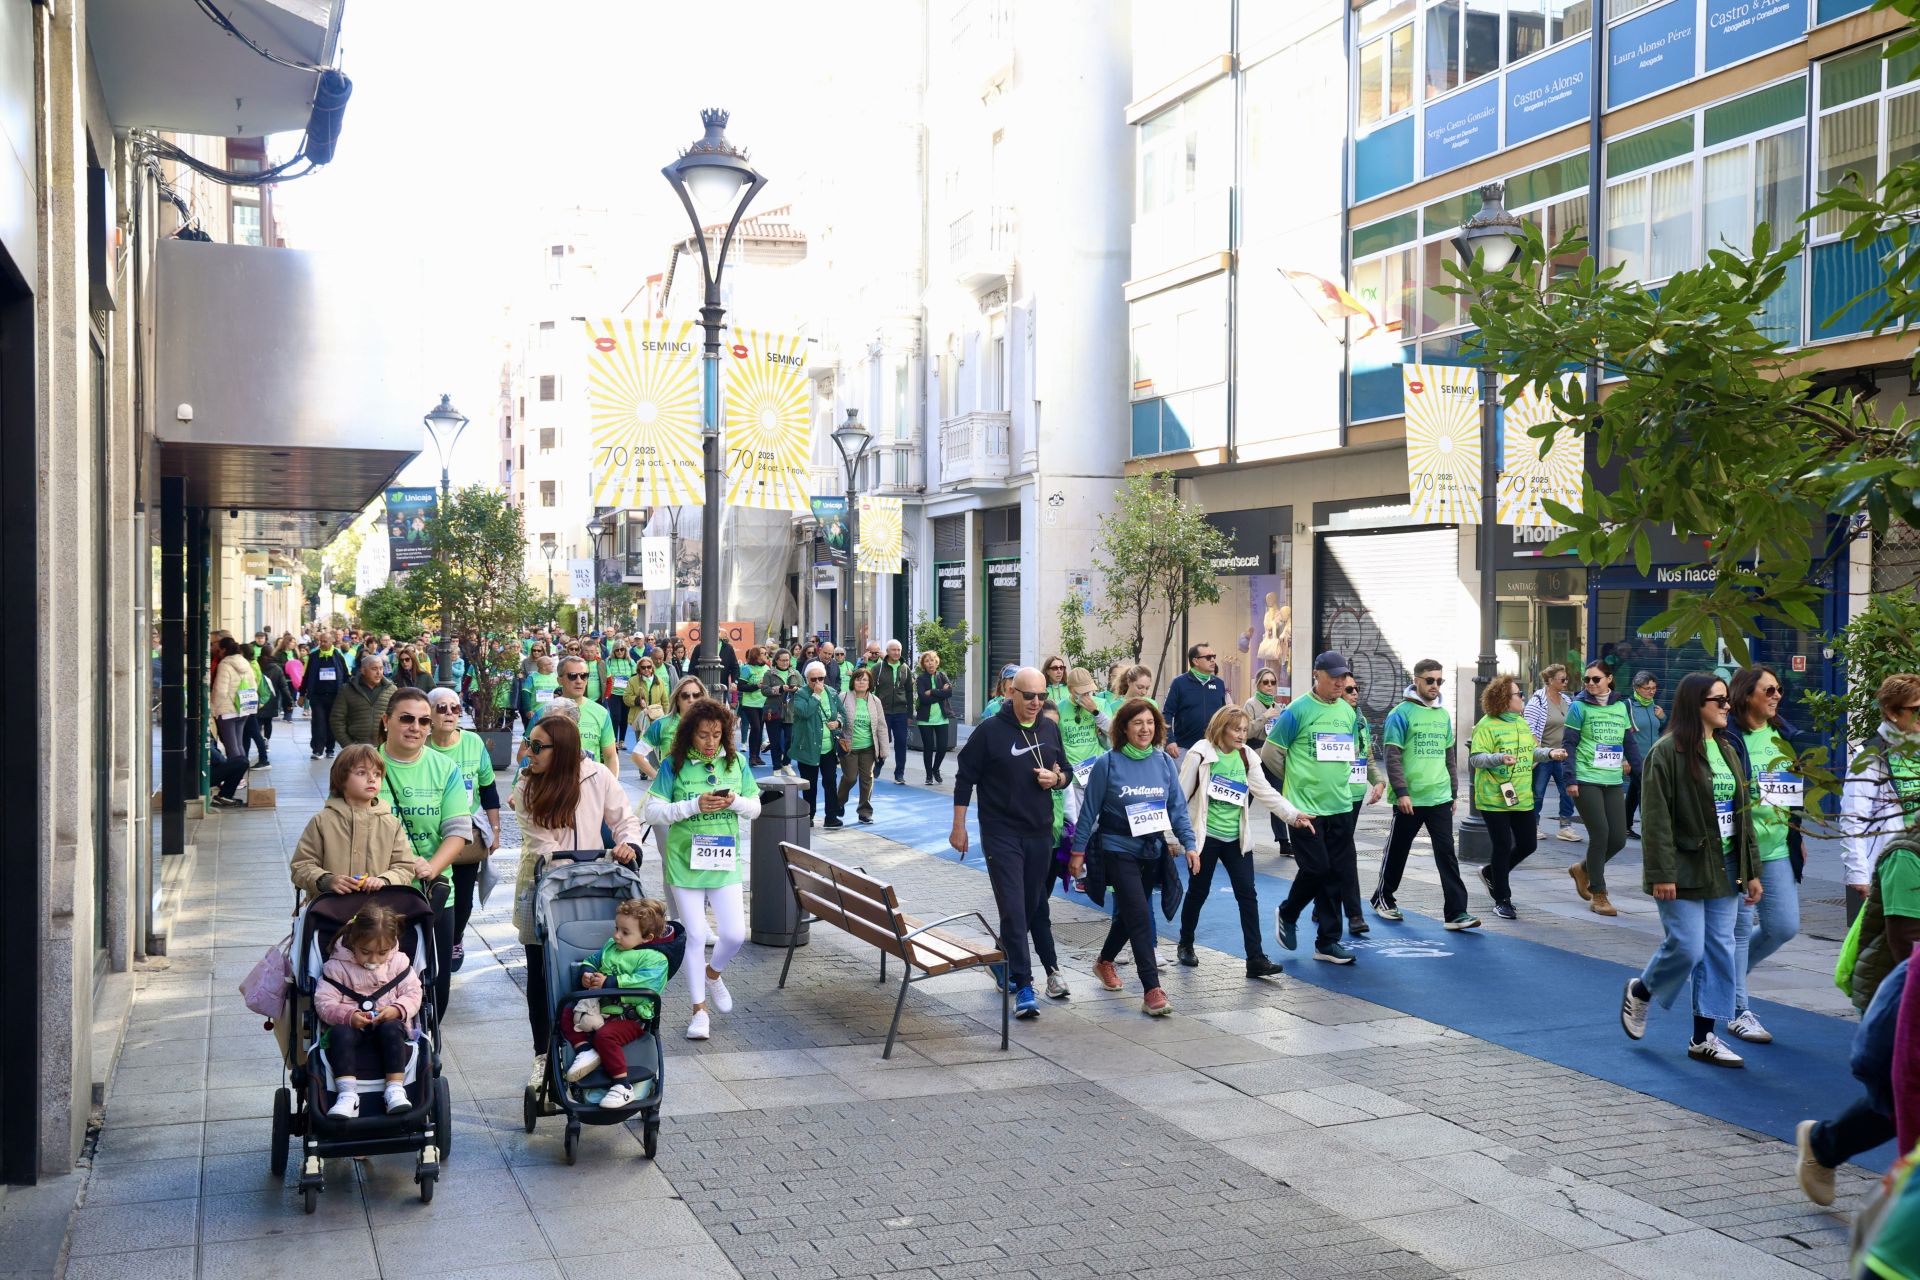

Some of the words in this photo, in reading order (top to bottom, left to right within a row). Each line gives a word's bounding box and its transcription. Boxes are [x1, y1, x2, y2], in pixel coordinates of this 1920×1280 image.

[1710, 3, 1749, 28] Castro
[1723, 18, 1751, 35] Abogados
[1751, 16, 1756, 24] y
[1756, 3, 1790, 21] Consultores
[1613, 50, 1636, 66] Laura
[1637, 38, 1666, 57] Alonso
[1667, 26, 1692, 44] Pérez
[1639, 54, 1664, 69] Abogada
[1513, 88, 1543, 108] Castro
[1544, 86, 1550, 95] &
[1550, 71, 1584, 93] Alonso
[1523, 101, 1544, 113] Abogados
[1548, 89, 1573, 104] Consultores
[1427, 127, 1446, 139] Sergio
[1446, 118, 1467, 131] Castro
[1467, 105, 1496, 124] González
[1443, 134, 1456, 145] Doctor
[1462, 126, 1479, 138] Derecho
[1452, 138, 1470, 150] Abogado
[641, 341, 691, 352] SEMINCI
[767, 352, 804, 367] SEMINCI
[1441, 384, 1475, 395] SEMINCI
[600, 446, 628, 467] 70
[634, 446, 656, 455] 2025
[758, 451, 775, 460] 2025
[635, 459, 645, 467] 24
[648, 459, 664, 467] oct.
[732, 448, 754, 470] 70
[758, 463, 767, 471] 24
[768, 464, 780, 472] oct.
[792, 467, 806, 475] nov.
[1414, 472, 1434, 491] 70
[1437, 473, 1453, 481] 2025
[1503, 475, 1526, 493] 70
[1530, 476, 1549, 484] 2025
[1447, 484, 1459, 492] oct.
[405, 493, 433, 503] Unicaja
[1548, 571, 1560, 591] 16
[1657, 567, 1682, 583] Nos
[1320, 743, 1351, 752] 36574
[1598, 752, 1621, 760] 34120
[1211, 784, 1242, 801] 36575
[1713, 782, 1734, 791] ntra
[1763, 784, 1796, 794] 37181
[1133, 811, 1164, 825] 29407
[696, 847, 733, 858] 20114
